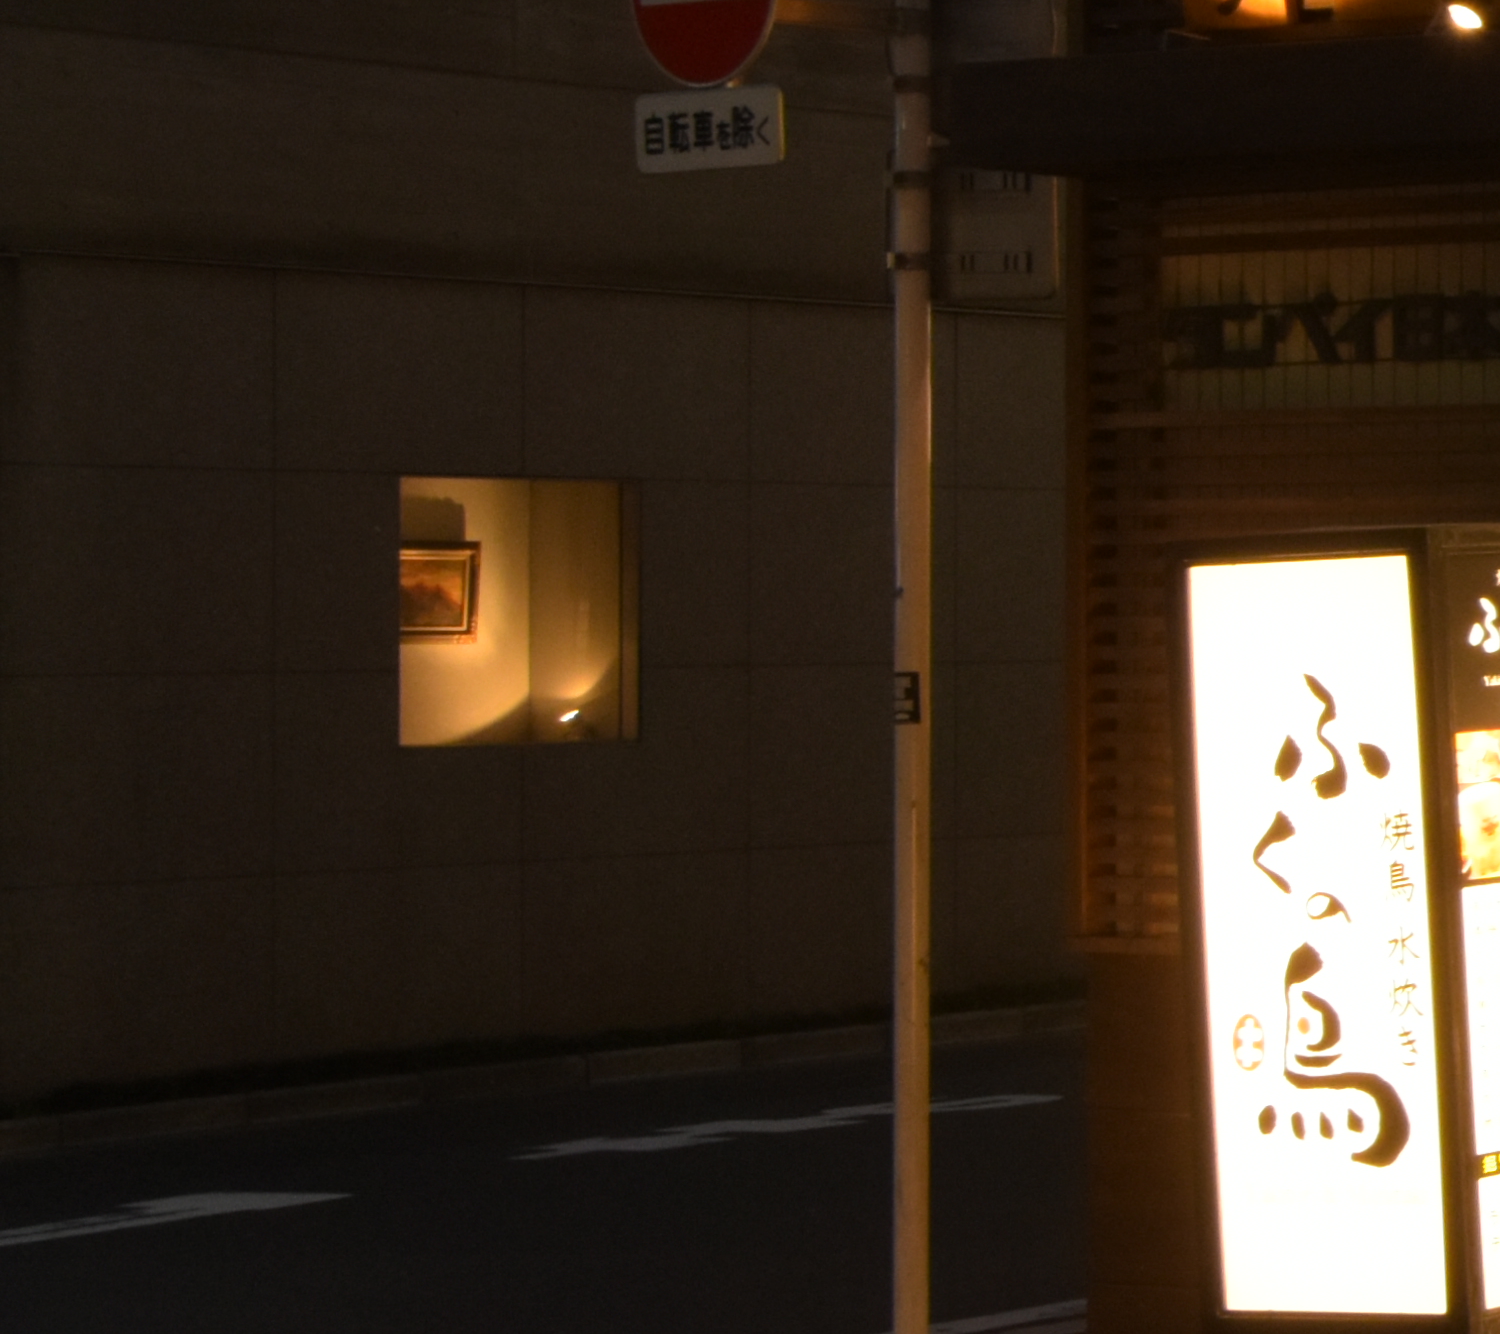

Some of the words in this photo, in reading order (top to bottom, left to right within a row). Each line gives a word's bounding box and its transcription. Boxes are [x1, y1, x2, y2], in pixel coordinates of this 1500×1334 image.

[645, 105, 771, 155] 自転車を除く
